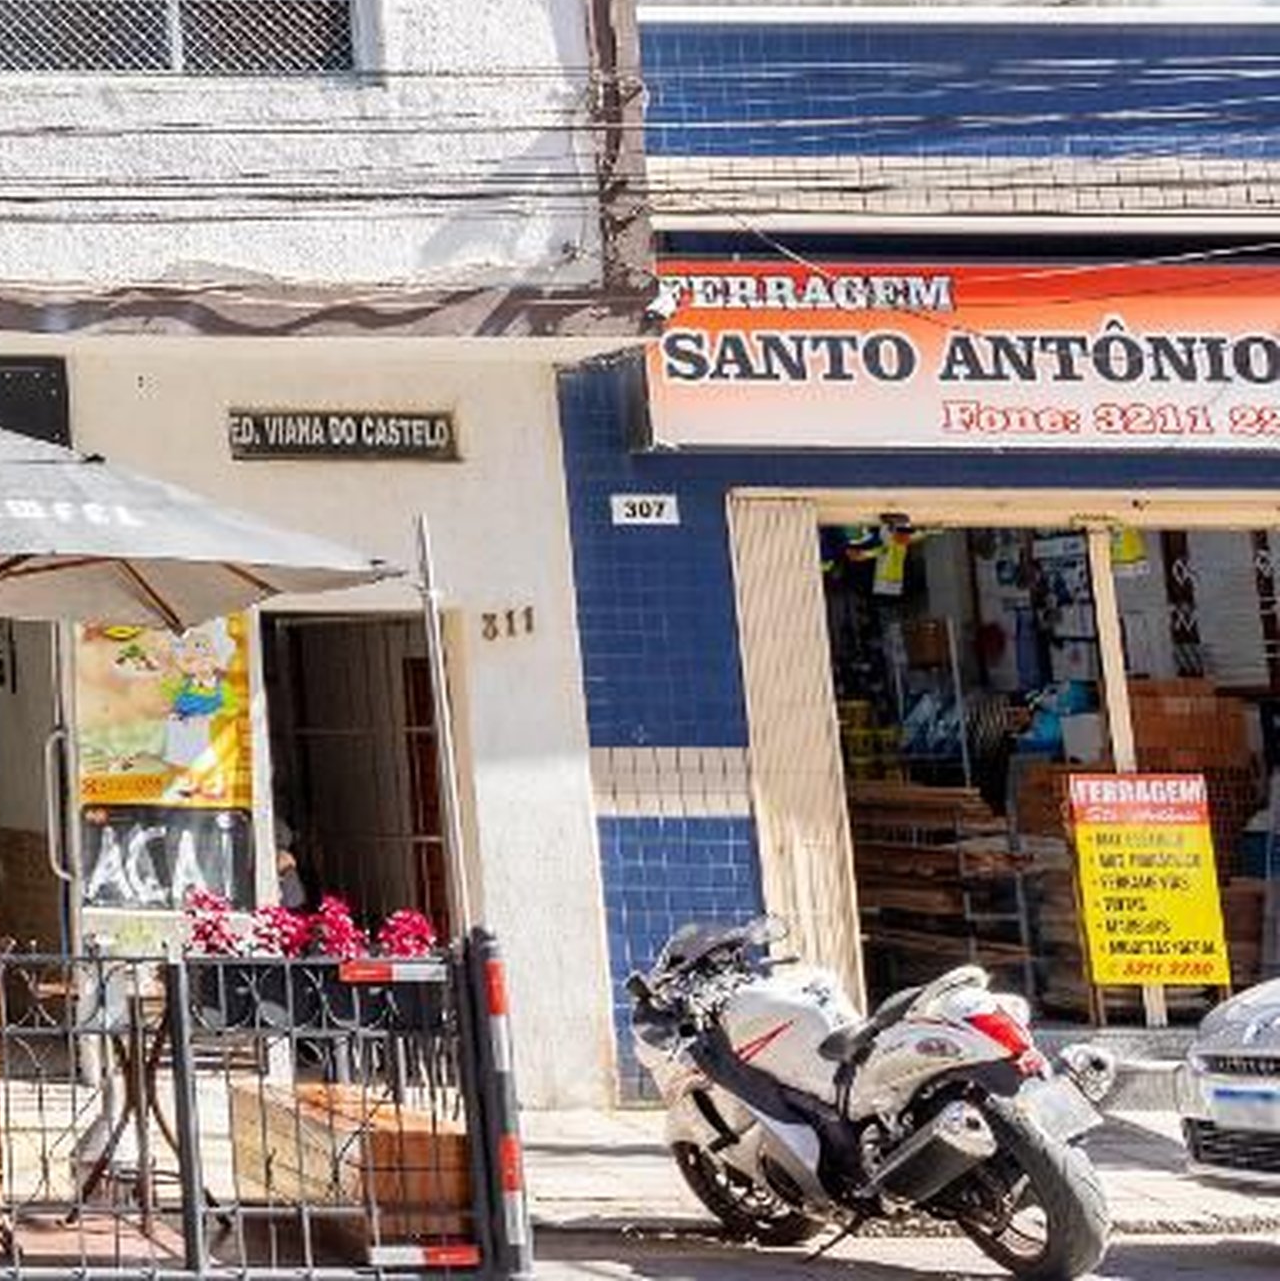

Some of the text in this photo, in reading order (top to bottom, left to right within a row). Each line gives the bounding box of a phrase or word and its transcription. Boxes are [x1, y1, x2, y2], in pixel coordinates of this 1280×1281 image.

[658, 274, 955, 313] FERRAGEM
[663, 330, 918, 383] SANTO
[328, 416, 357, 446] DO
[360, 416, 450, 448] CASTELO
[942, 399, 1081, 435] Fone:
[1094, 402, 1215, 435] 3211
[623, 500, 667, 519] 307
[482, 606, 535, 641] 311
